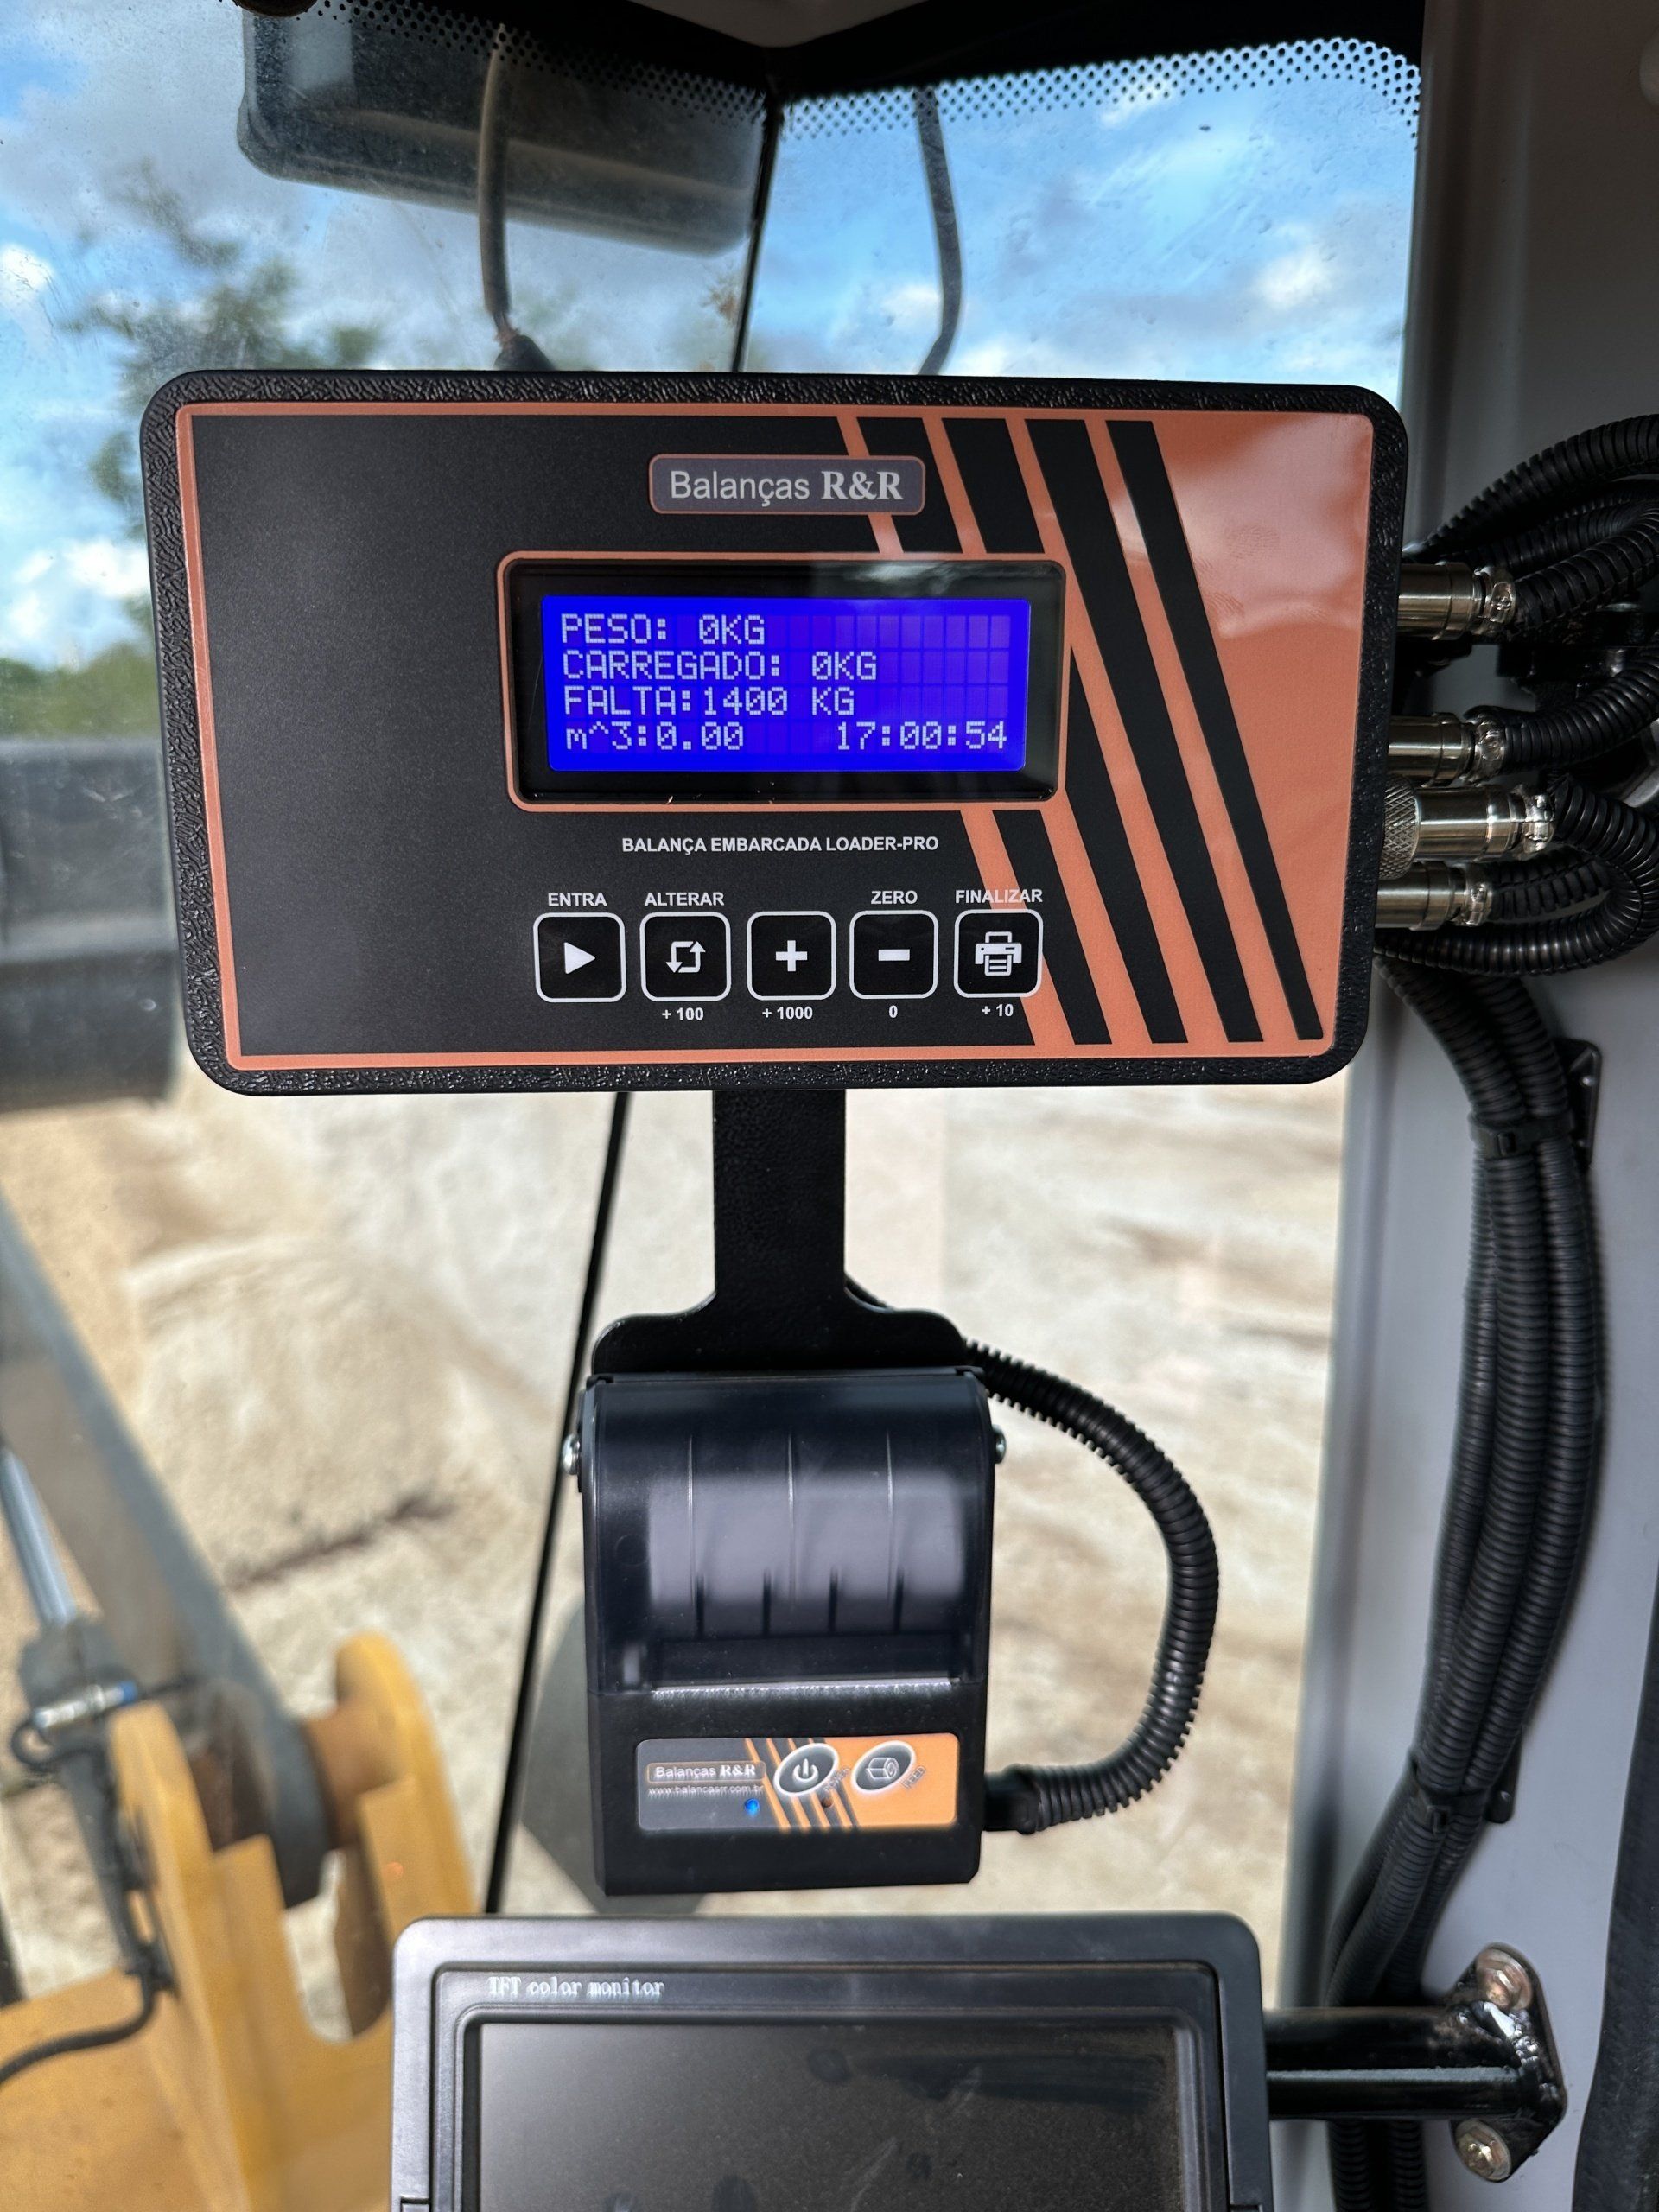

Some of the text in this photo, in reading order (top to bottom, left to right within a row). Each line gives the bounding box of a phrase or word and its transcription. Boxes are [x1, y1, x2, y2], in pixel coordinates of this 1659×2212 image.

[671, 471, 904, 505] Balanças R&R
[561, 613, 765, 644] PESO: 0KG
[563, 651, 876, 681] CARREGADO: 0KG
[811, 688, 855, 716] KG
[837, 721, 1007, 750] 17:00:54
[622, 836, 939, 855] BALANÇA EMBARCADA LOADER-PRO
[548, 892, 607, 906] ENTRA
[645, 892, 724, 906] ALTERAR
[871, 890, 918, 905] ZERO
[956, 889, 1043, 904] FINALIZAR
[676, 1007, 704, 1021] 100
[776, 1007, 813, 1020] 1000
[888, 1005, 898, 1019] 0
[995, 1004, 1014, 1018] 10
[655, 1764, 756, 1778] Balanças R&R
[487, 1976, 665, 1995] TFT color monitor
